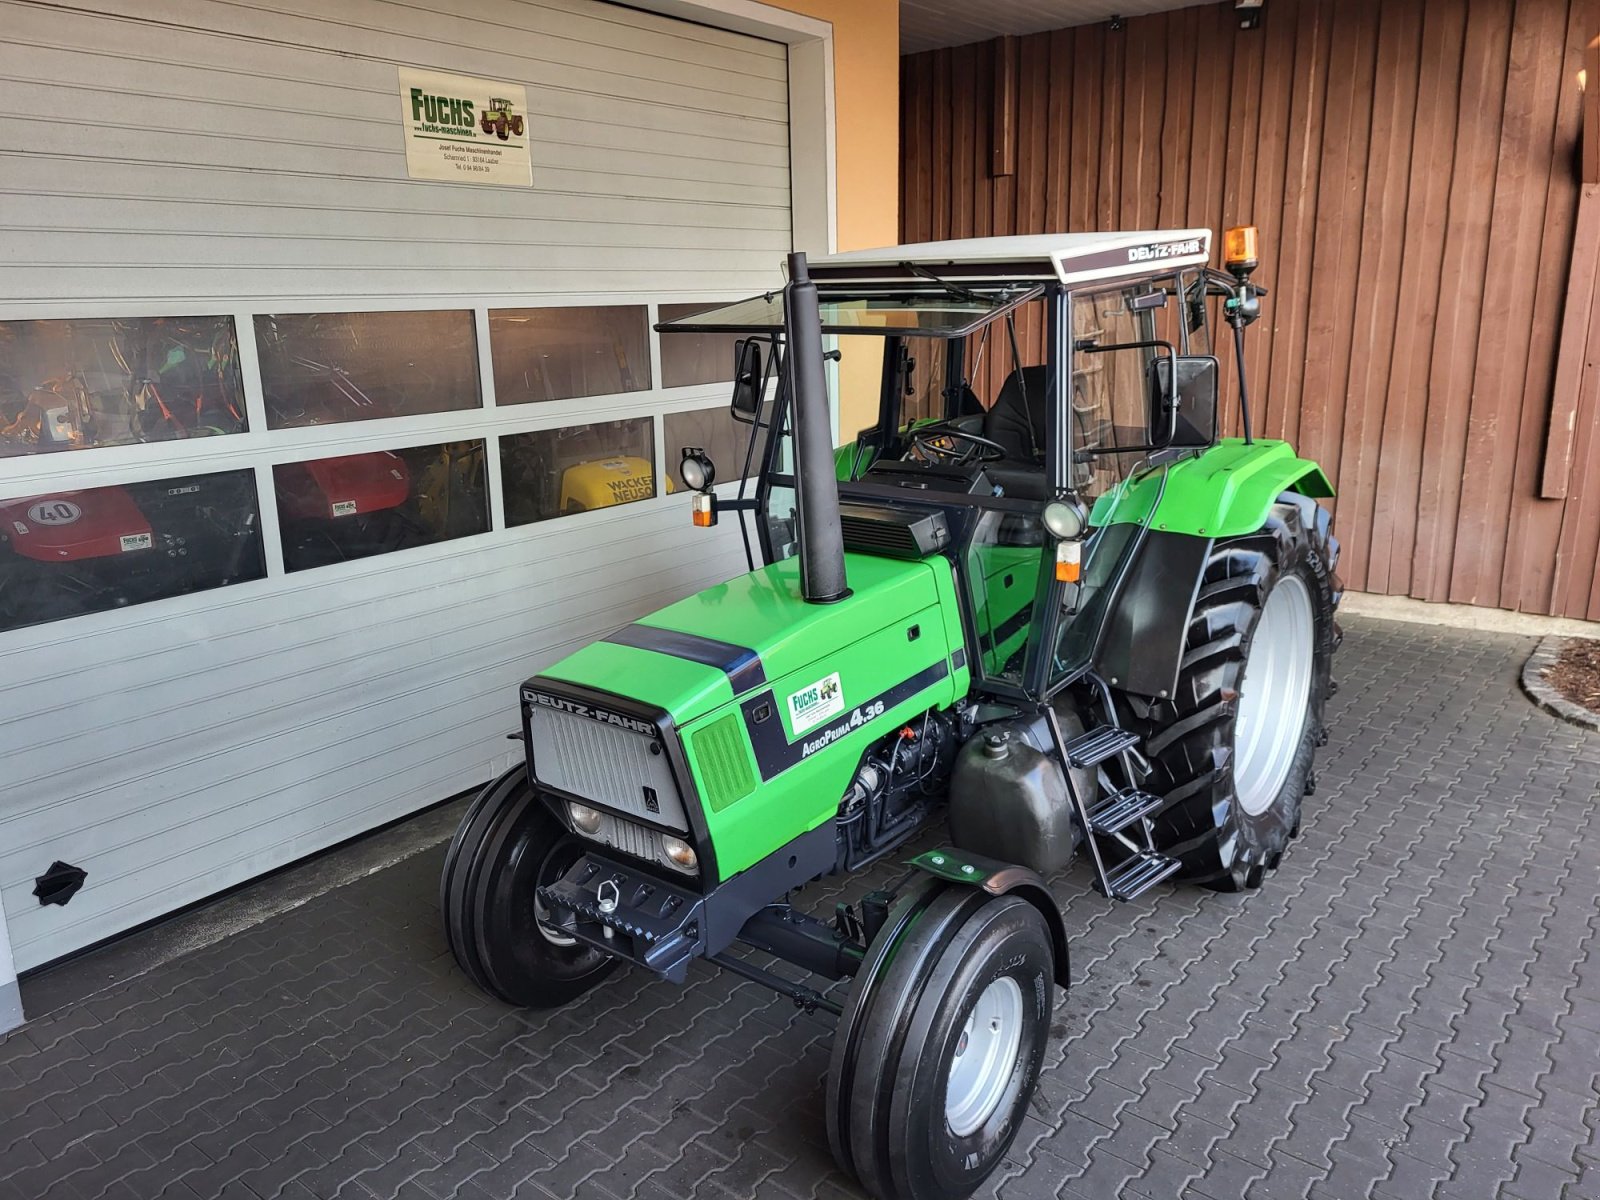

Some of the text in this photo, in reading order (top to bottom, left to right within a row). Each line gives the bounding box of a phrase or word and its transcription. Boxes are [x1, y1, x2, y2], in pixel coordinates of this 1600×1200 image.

[410, 88, 475, 127] FUCHS
[606, 475, 652, 491] WACKE
[612, 486, 652, 502] NEUSO
[39, 503, 74, 521] 40
[792, 687, 818, 711] FUCHS
[523, 690, 653, 735] DEUTZ-FAHR
[850, 700, 885, 728] 4.36
